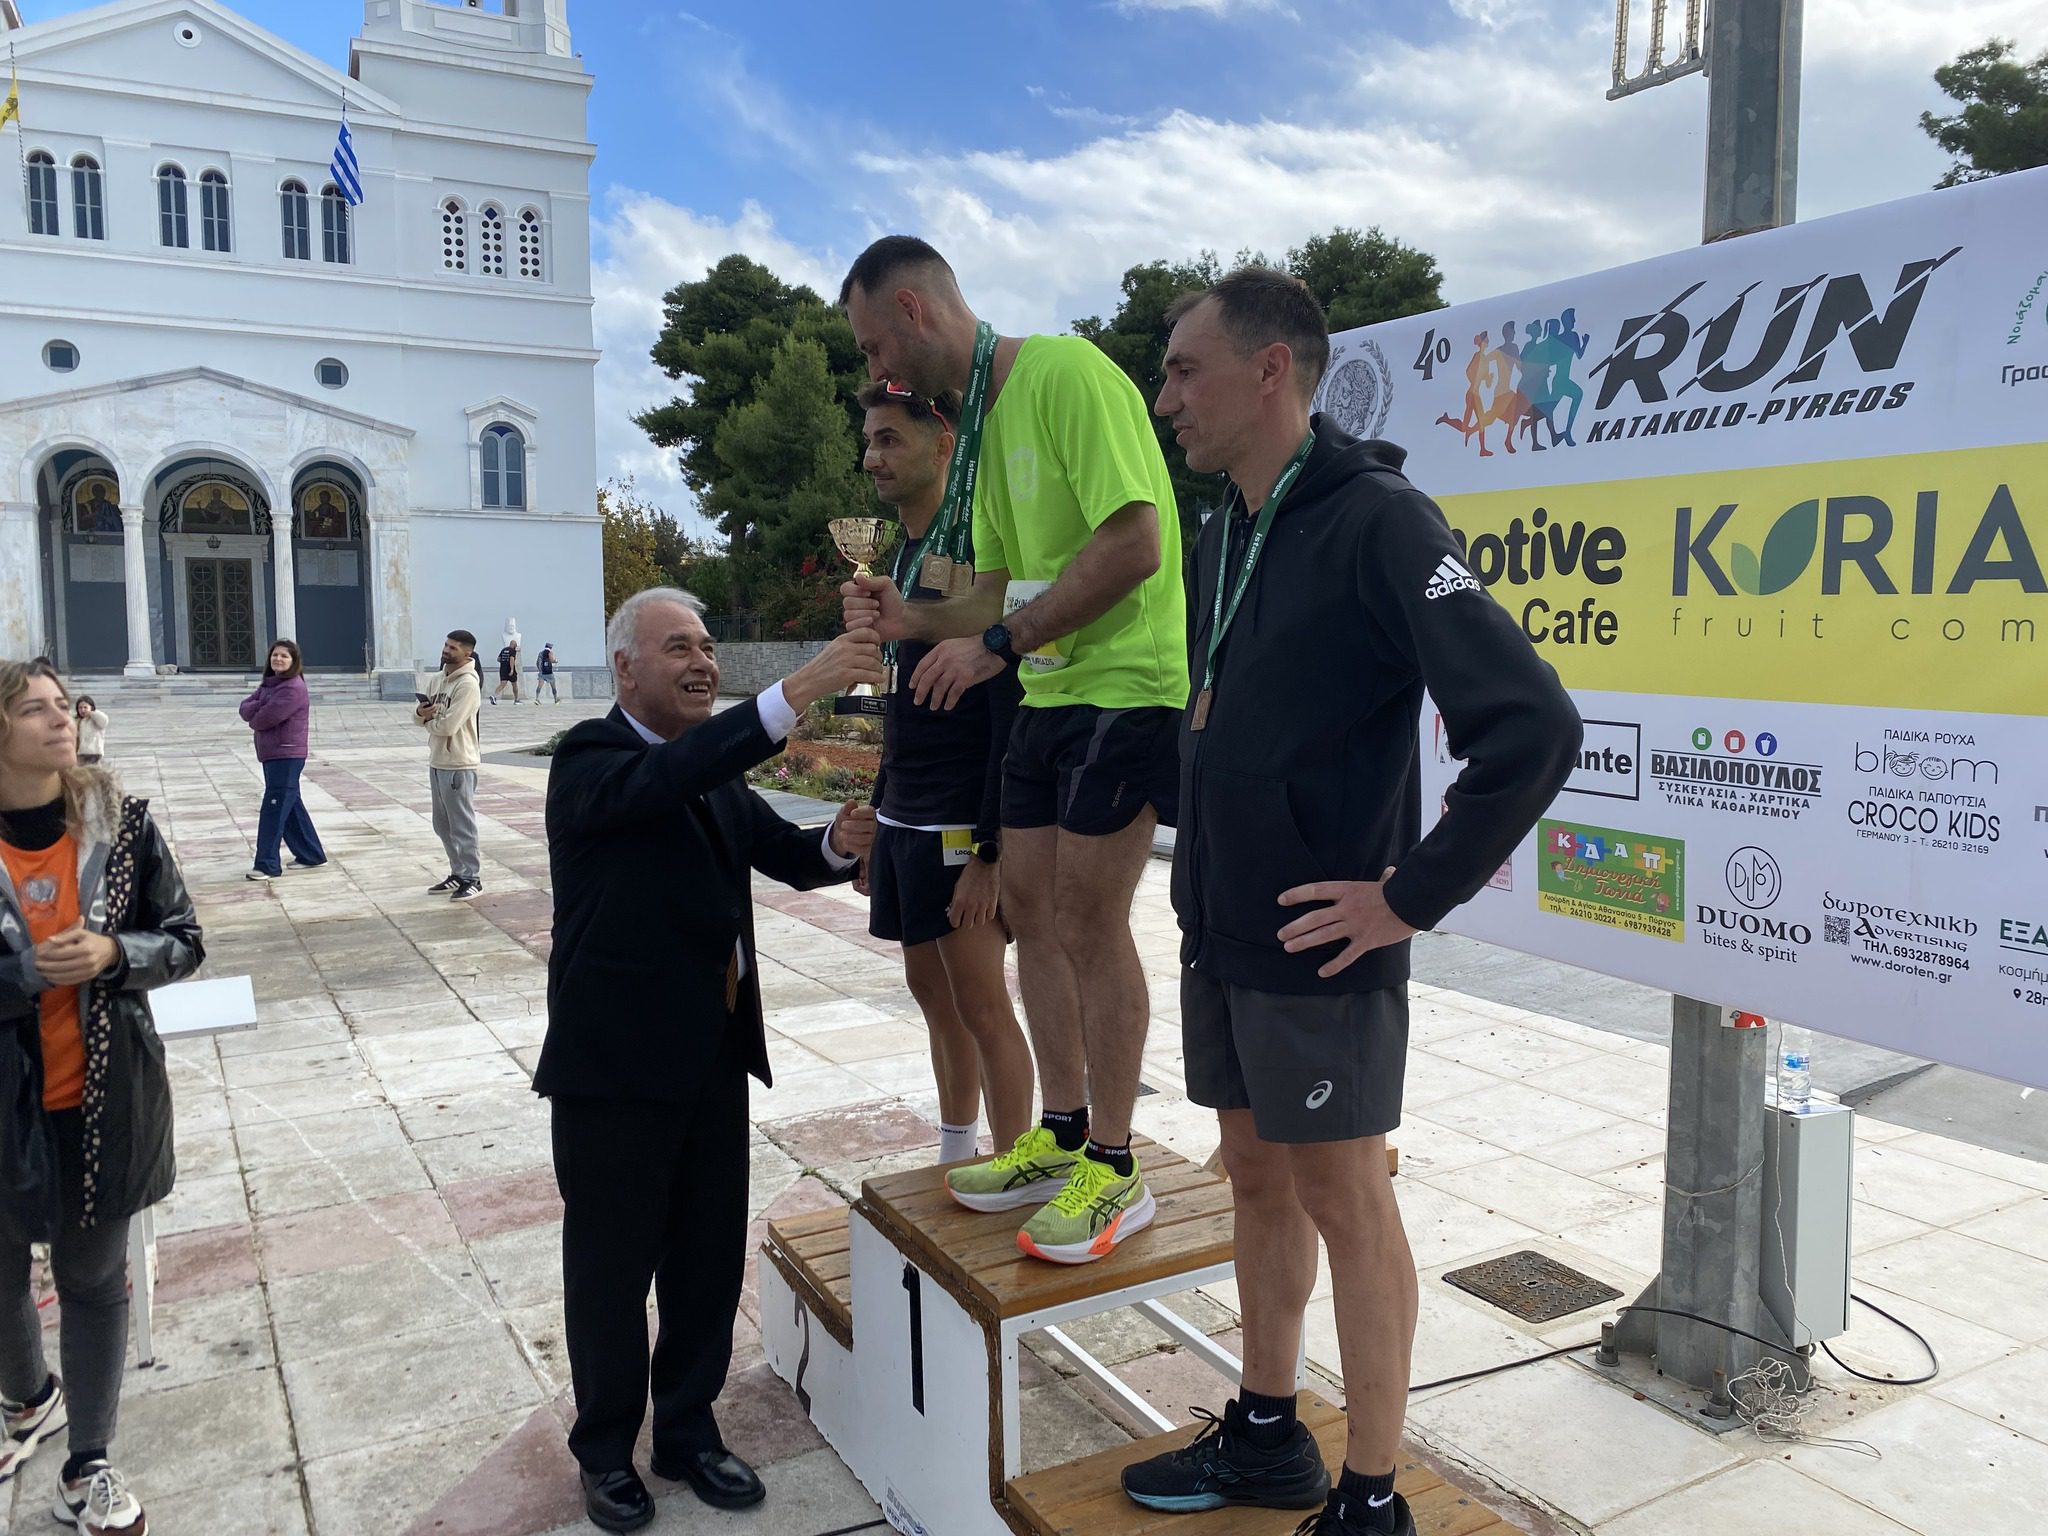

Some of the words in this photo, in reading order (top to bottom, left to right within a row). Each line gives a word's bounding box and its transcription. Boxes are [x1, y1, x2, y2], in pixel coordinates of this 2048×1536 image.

[1589, 246, 1964, 410] RUN
[1586, 381, 1915, 444] KATAKOLO-PYRGOS
[955, 435, 968, 466] istante
[965, 460, 976, 491] istante
[1271, 461, 1301, 499] Locomotive
[1246, 532, 1263, 571] istante
[1450, 506, 1627, 586] otive
[1425, 575, 1480, 600] adidas
[1522, 597, 1619, 646] Cafe
[1672, 607, 1824, 639] fruit
[1891, 615, 2036, 642] com
[1884, 729, 1930, 743] ΠΑΙΔΙΚΑ
[1935, 732, 1976, 746] ΡΟΥΧΑ
[1651, 753, 1822, 793] ΒΑΣΙΛΟΠΟΥΛΟΣ
[1658, 781, 1738, 800] ΣΥΣΚΕΥΑΣΙΑ
[1749, 792, 1811, 809] ΧΑΡΤΙΚΑ
[1666, 794, 1704, 808] ΥΛΙΚΑ
[1711, 800, 1801, 820] ΚΑΘΑΡΙΣΜΟΥ
[1869, 786, 1914, 801] ΠΑΙΔΙΚΑ
[1919, 791, 1987, 809] ΠΑΠΟΥΤΣΙΑ
[1848, 800, 1938, 834] CROCO
[1948, 810, 2001, 842] KIDS
[1856, 829, 1901, 843] ΓΕΡΜΑΝΟΥ
[1904, 836, 1909, 844] 3
[1932, 839, 1959, 850] 26210
[1962, 843, 1989, 854] 32169
[1570, 908, 1592, 919] 26210
[1594, 912, 1616, 924] 30224
[1578, 901, 1597, 911] Αγίου
[1598, 906, 1636, 920] Αθανασίου
[1648, 916, 1676, 930] Πύργος
[1696, 904, 1812, 945] DUOMO
[1703, 929, 1737, 950] bites
[1741, 938, 1754, 954] &
[1758, 945, 1798, 963] spirit
[1850, 953, 1953, 984] www.doroten.gr
[902, 1260, 925, 1418] 1
